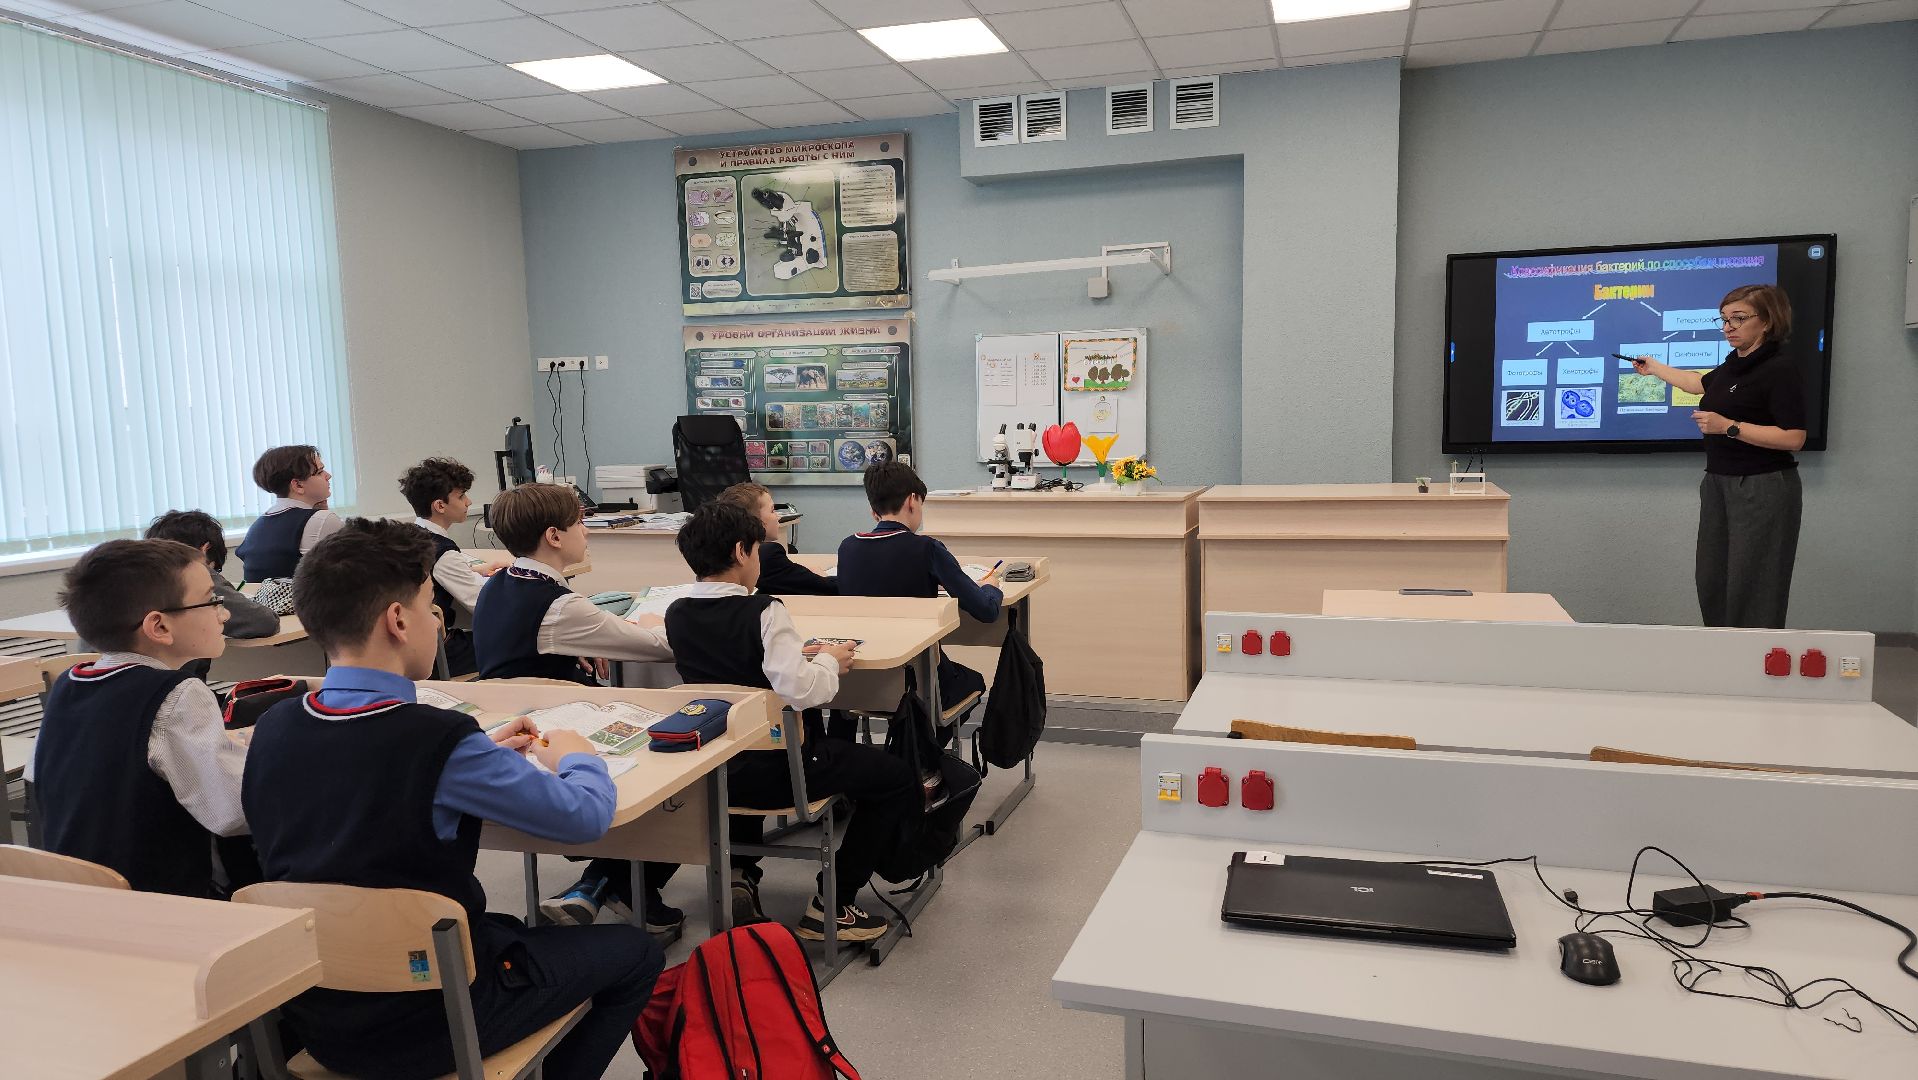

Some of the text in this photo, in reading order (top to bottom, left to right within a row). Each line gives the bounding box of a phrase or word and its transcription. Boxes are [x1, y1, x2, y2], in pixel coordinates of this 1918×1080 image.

[719, 141, 855, 158] УСТРОЙСТВО МИКРОСКОПА
[730, 157, 776, 167] ПРАВИЛА
[779, 154, 820, 163] РАБОТЫ
[832, 151, 855, 159] НИМ
[1510, 264, 1593, 276] Классификация
[1596, 259, 1644, 273] бактерий
[1647, 260, 1661, 269] по
[1593, 284, 1654, 300] Бактерии
[711, 327, 881, 340] УРОВНИ ОРГАНИЗАЦИИ ЖИЗНИ
[1540, 328, 1581, 336] Автотрофы
[1562, 367, 1599, 375] Хемотрофы
